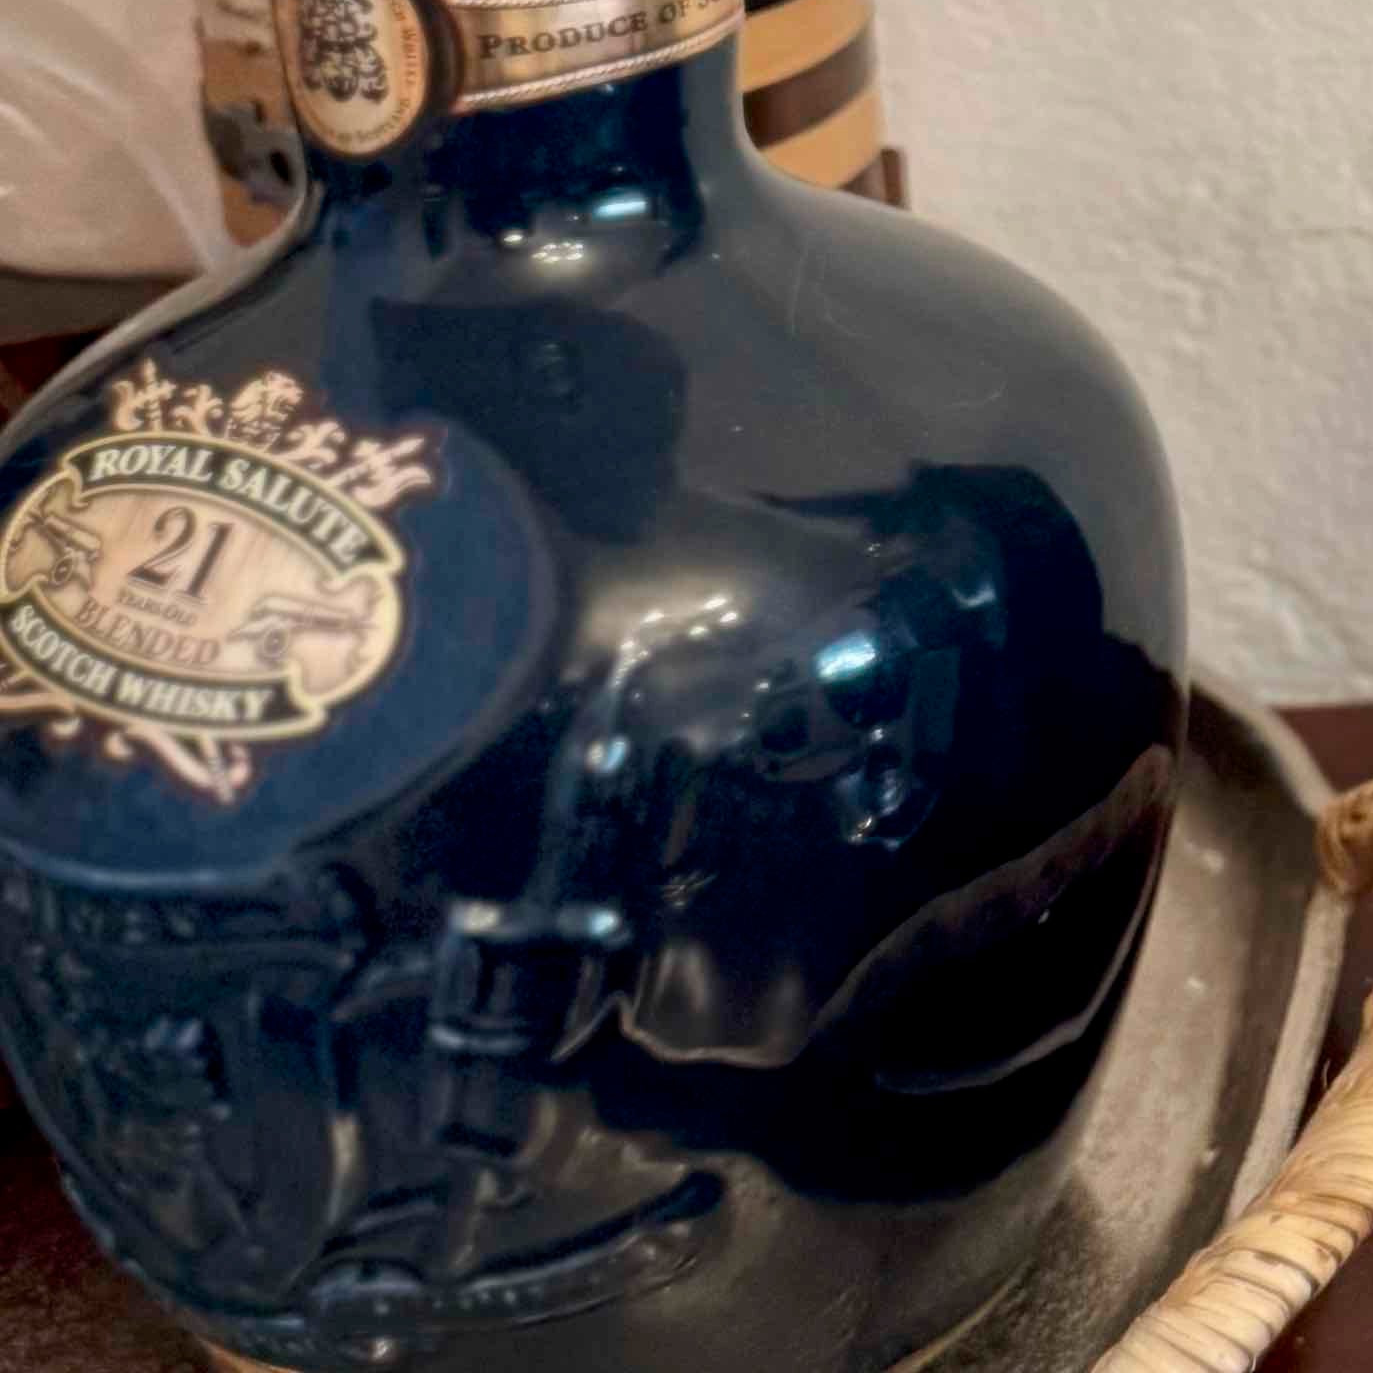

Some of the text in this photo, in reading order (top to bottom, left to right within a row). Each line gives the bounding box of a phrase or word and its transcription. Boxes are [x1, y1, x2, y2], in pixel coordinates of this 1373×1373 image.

[479, 11, 648, 59] PRODUCE
[90, 444, 371, 562] ROYAL SALUTE
[128, 506, 236, 600] 21
[11, 605, 274, 722] SCOTCH WHISKY
[75, 598, 222, 666] BLENDED
